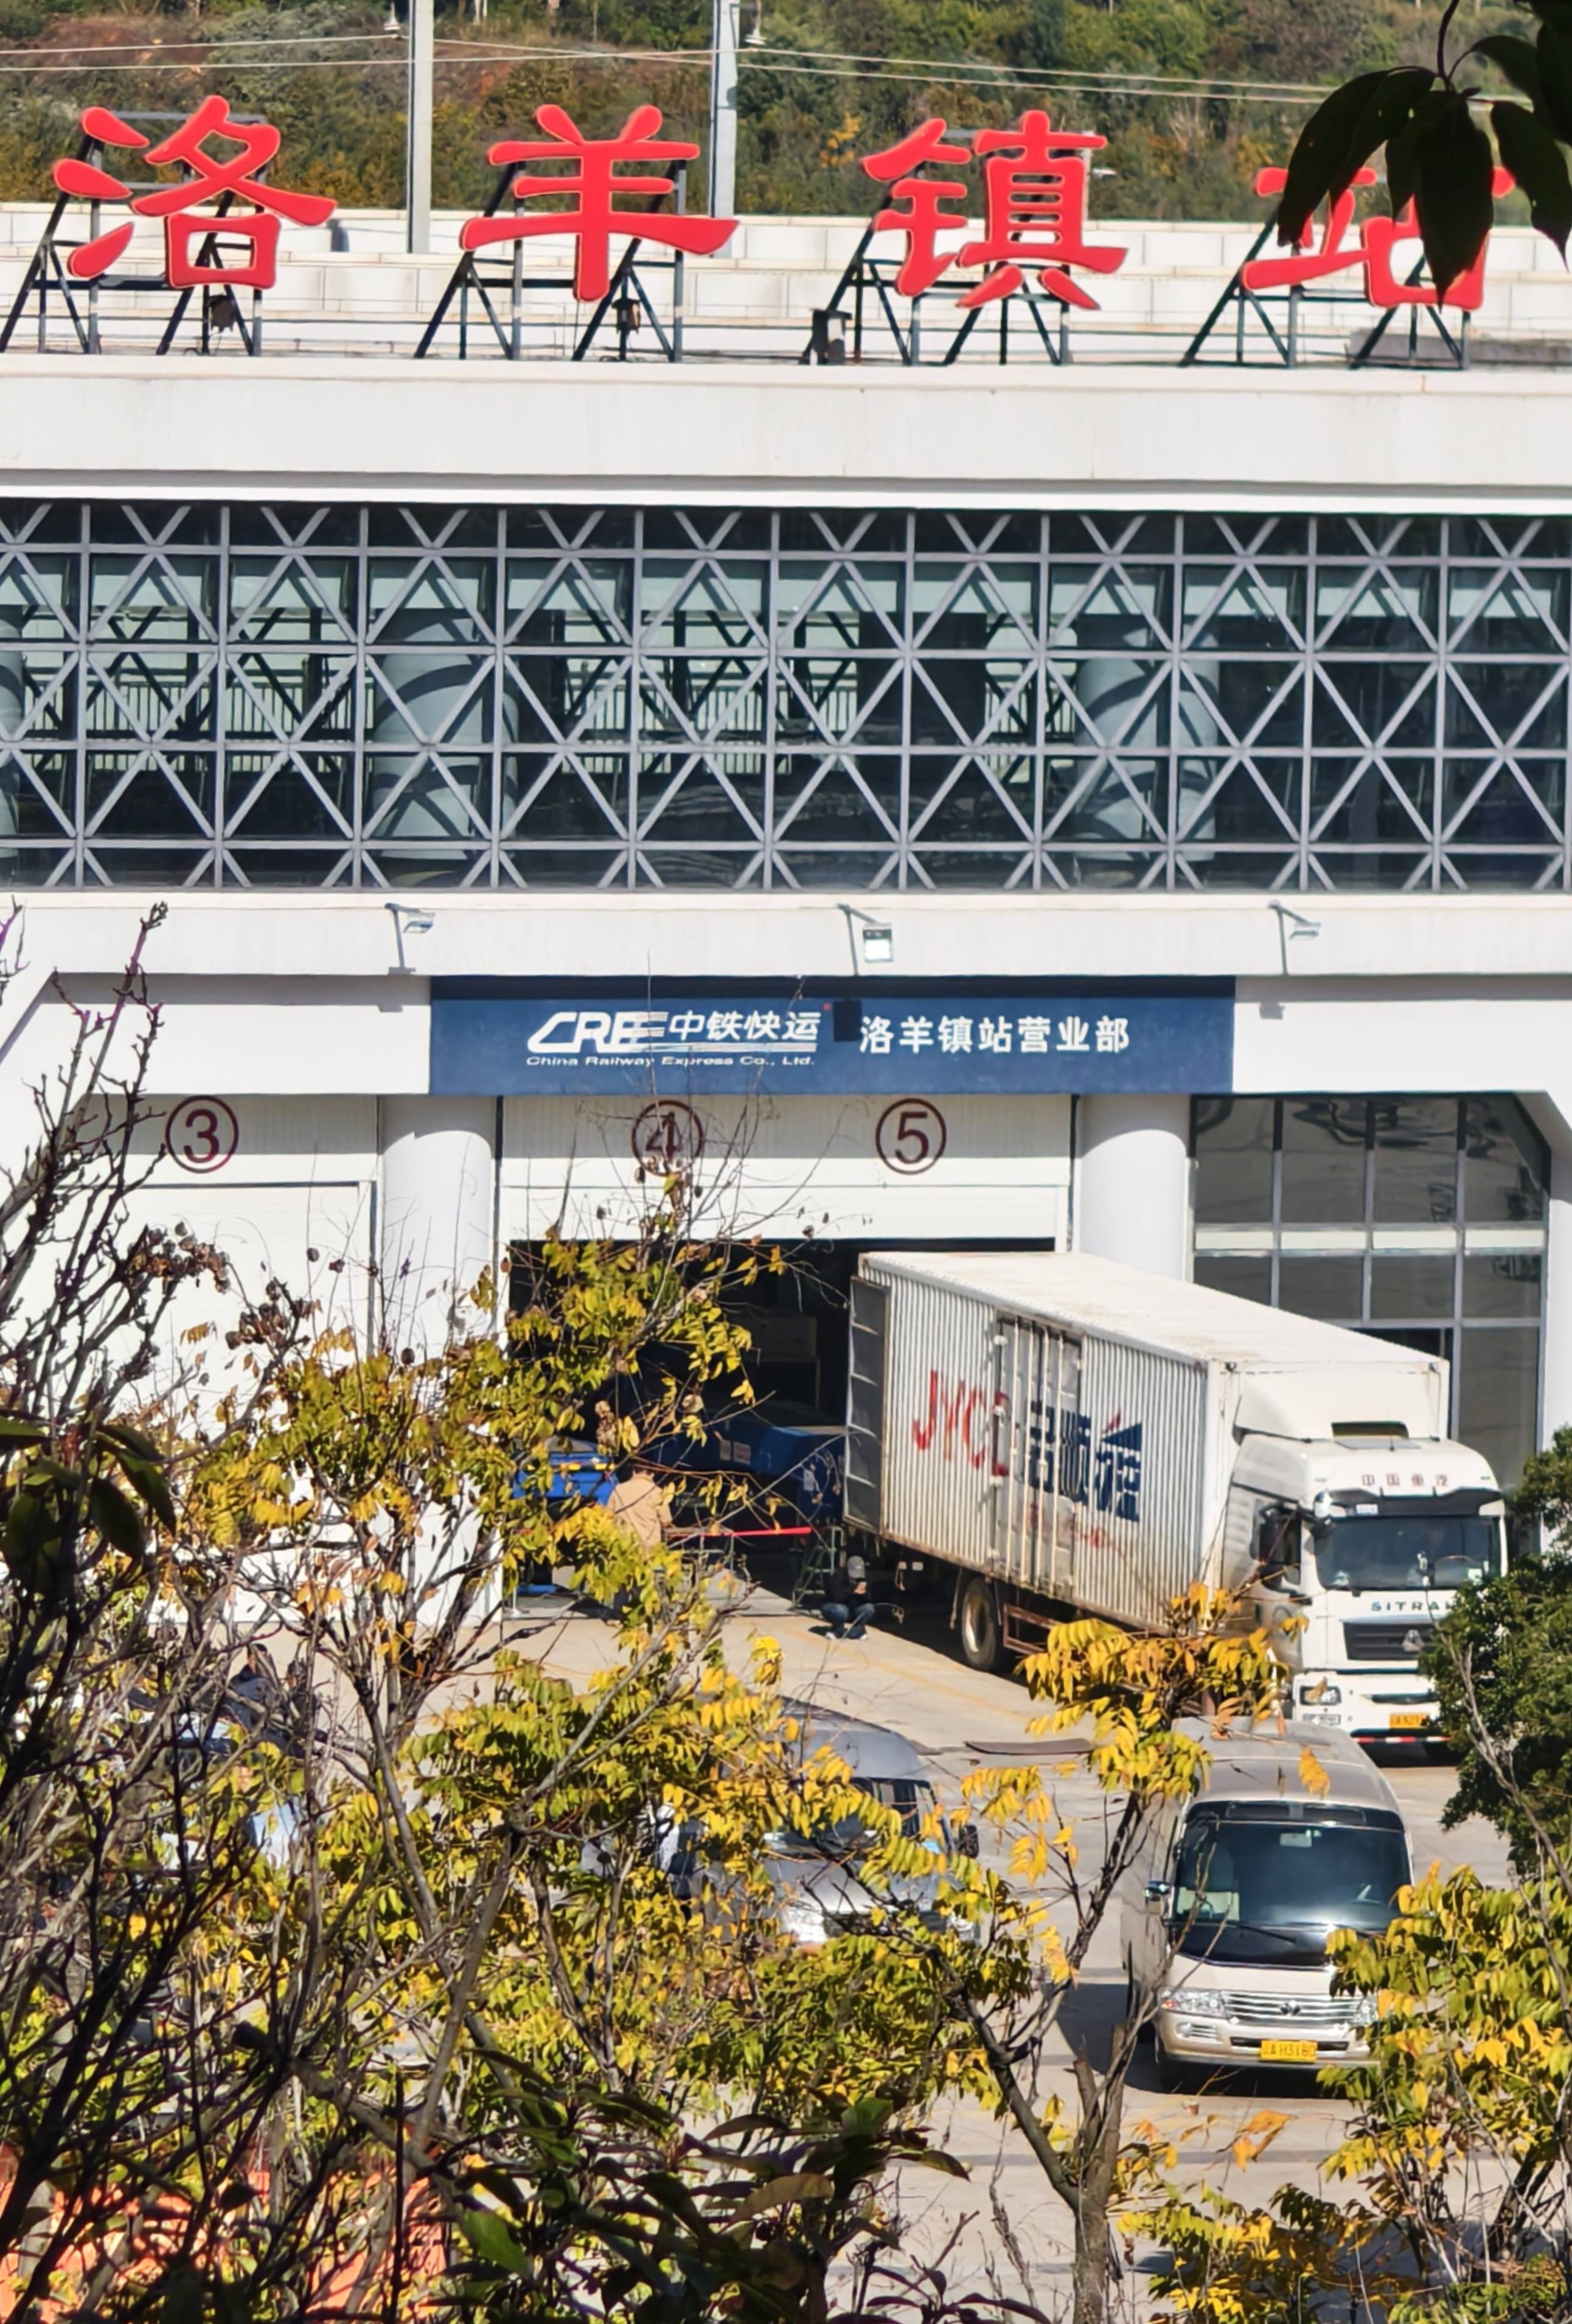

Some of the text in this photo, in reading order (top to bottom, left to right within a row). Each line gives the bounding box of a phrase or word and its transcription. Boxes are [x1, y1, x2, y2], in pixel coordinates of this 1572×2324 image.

[669, 1010, 821, 1041] 中铁快运
[860, 1015, 1130, 1054] 洛羊镇站营业部
[526, 1056, 815, 1068] China Railway Express Co., Ltd.
